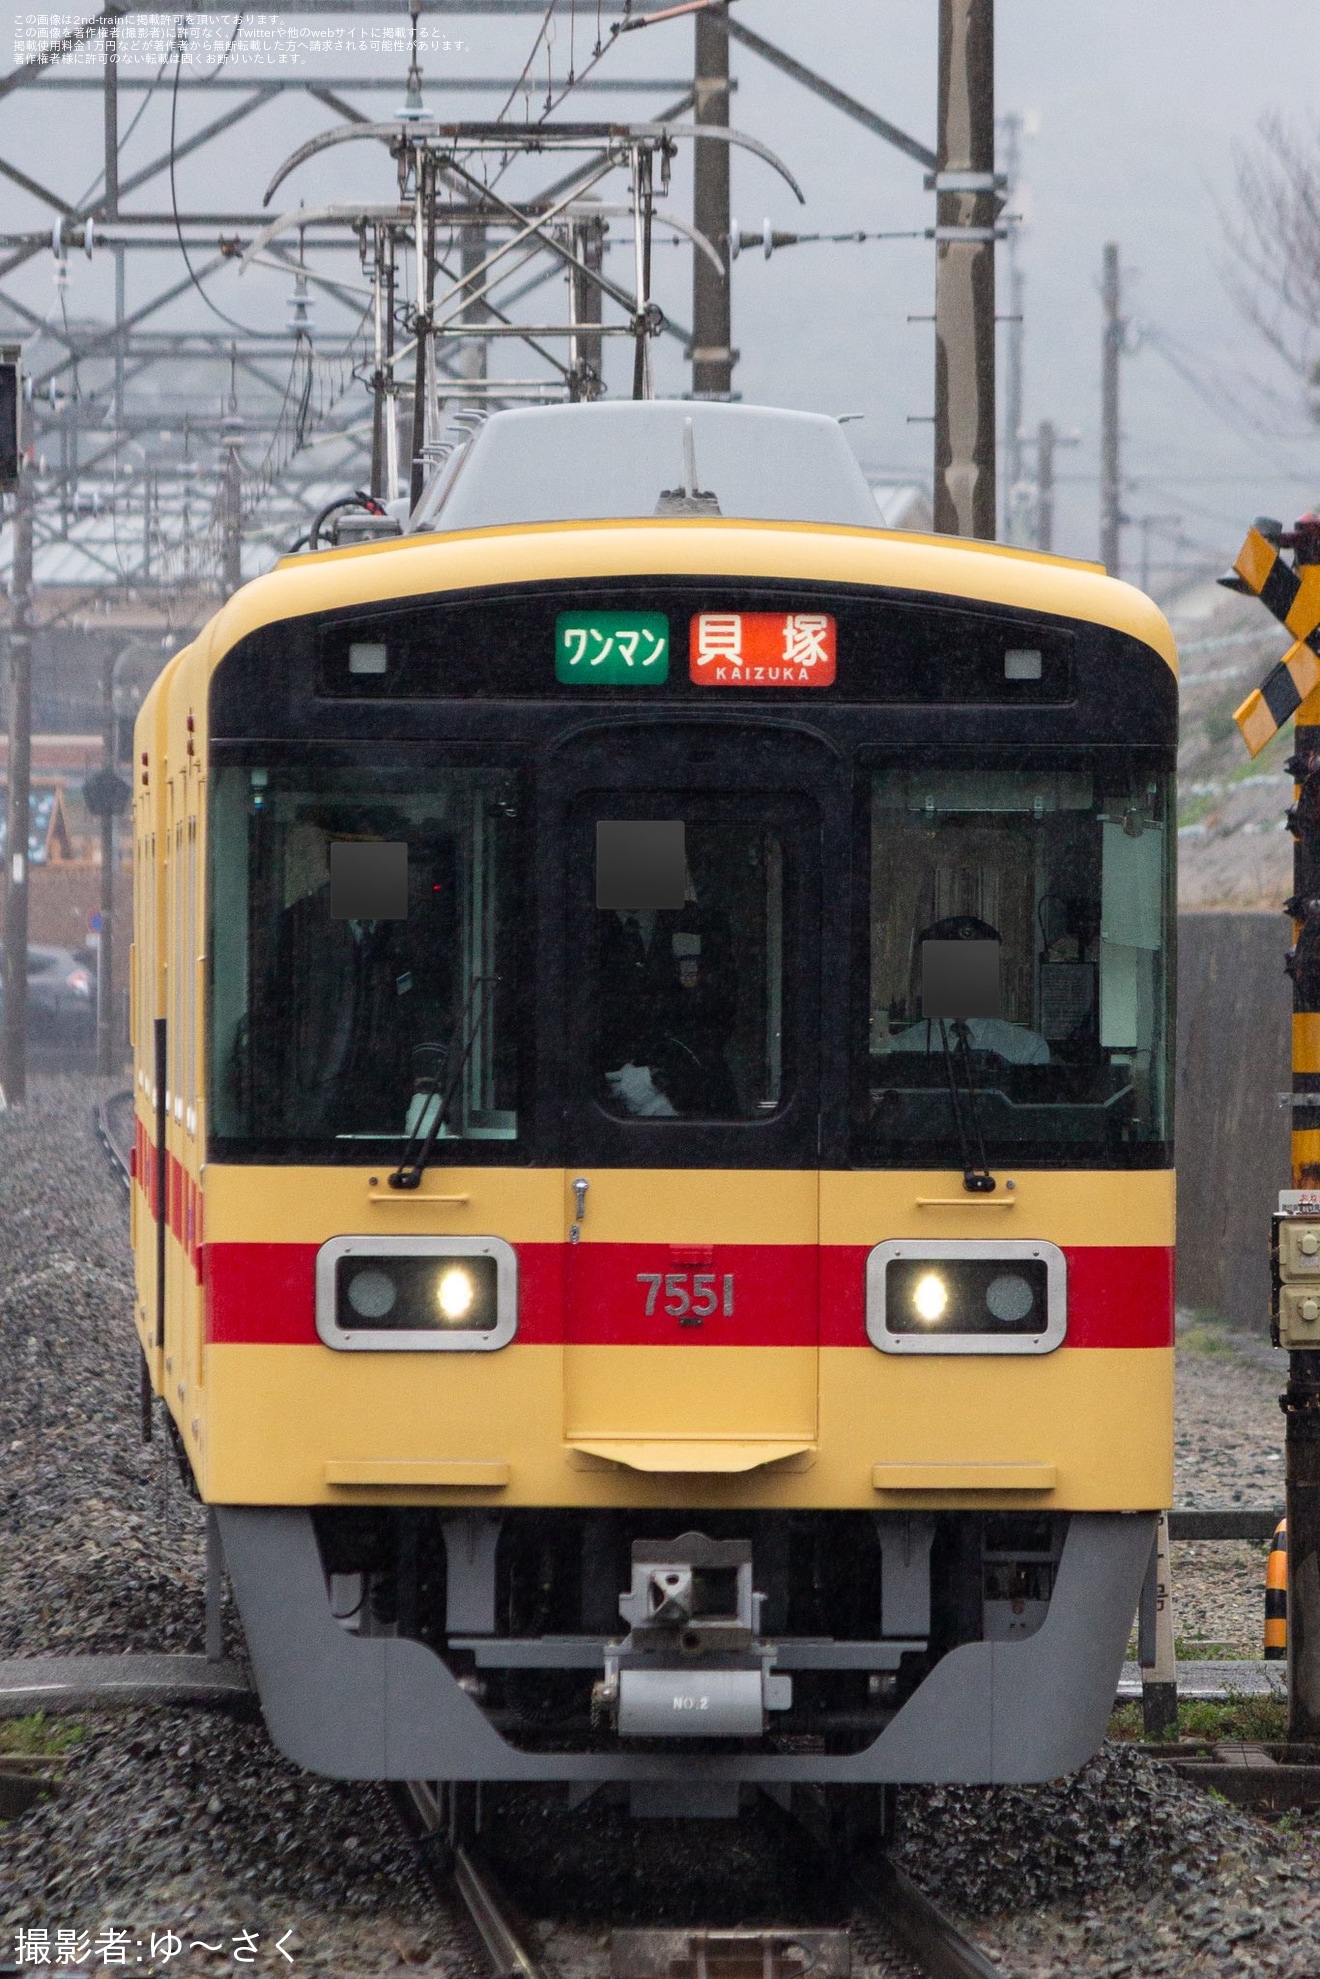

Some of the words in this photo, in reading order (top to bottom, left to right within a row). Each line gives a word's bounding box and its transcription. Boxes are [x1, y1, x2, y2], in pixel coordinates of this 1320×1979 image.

[564, 628, 665, 667] ワンマン
[696, 614, 829, 667] 貝塚
[716, 667, 809, 680] KAIZUKA
[636, 1273, 734, 1317] 7551
[673, 1696, 709, 1710] NO.2
